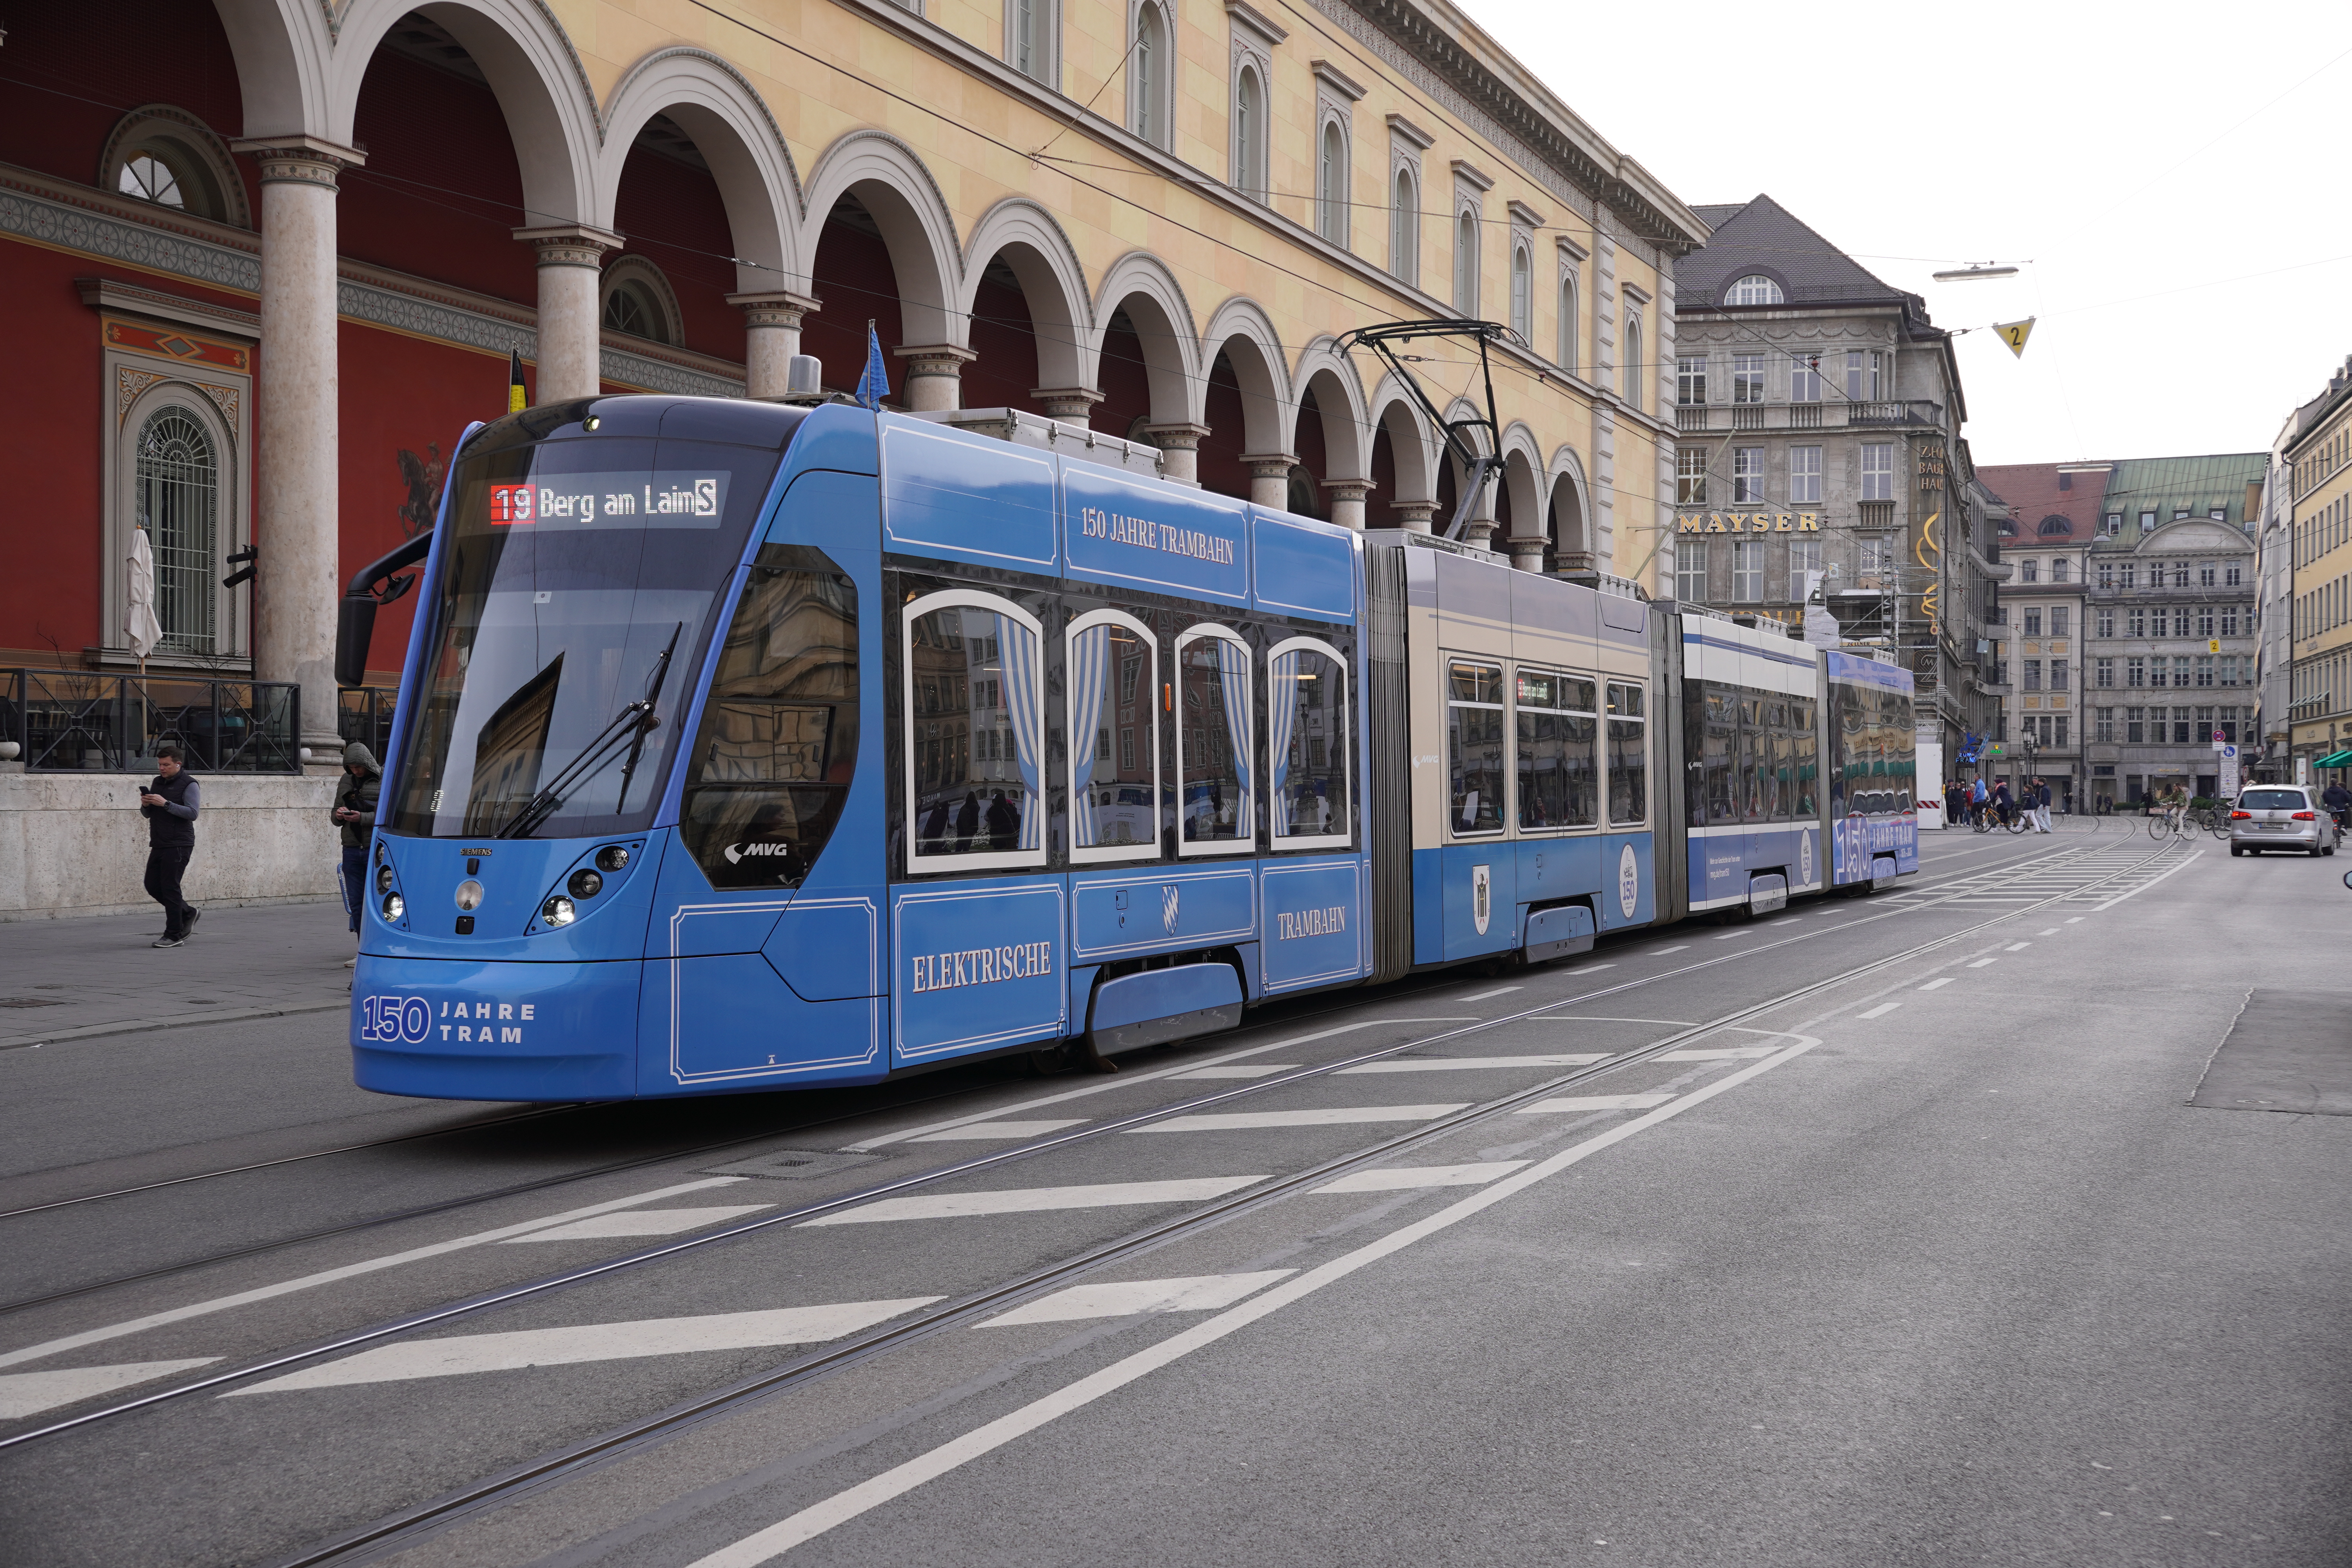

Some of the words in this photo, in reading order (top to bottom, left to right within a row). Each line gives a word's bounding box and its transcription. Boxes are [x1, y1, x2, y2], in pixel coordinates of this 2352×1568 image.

[2011, 327, 2021, 346] 2
[495, 489, 530, 520] 19
[540, 488, 594, 523] Berg
[604, 494, 635, 515] am
[645, 485, 695, 514] Laim
[1678, 512, 1819, 533] MAYSER
[1082, 506, 1106, 539] 150
[1110, 513, 1157, 550] JAHRE
[1160, 524, 1234, 566] TRAMBAHN
[1420, 755, 1439, 764] MVG
[1873, 828, 1894, 849] JAHRE
[1896, 825, 1913, 846] TRAM
[743, 843, 787, 856] MVG
[1835, 817, 1869, 884] 150
[1623, 880, 1634, 900] 150
[1278, 906, 1345, 940] TRAMBAHN
[913, 942, 1051, 993] ELEKTRISCHE
[362, 995, 431, 1044] 150
[441, 1002, 535, 1020] JAHRE
[440, 1025, 521, 1044] TRAM
